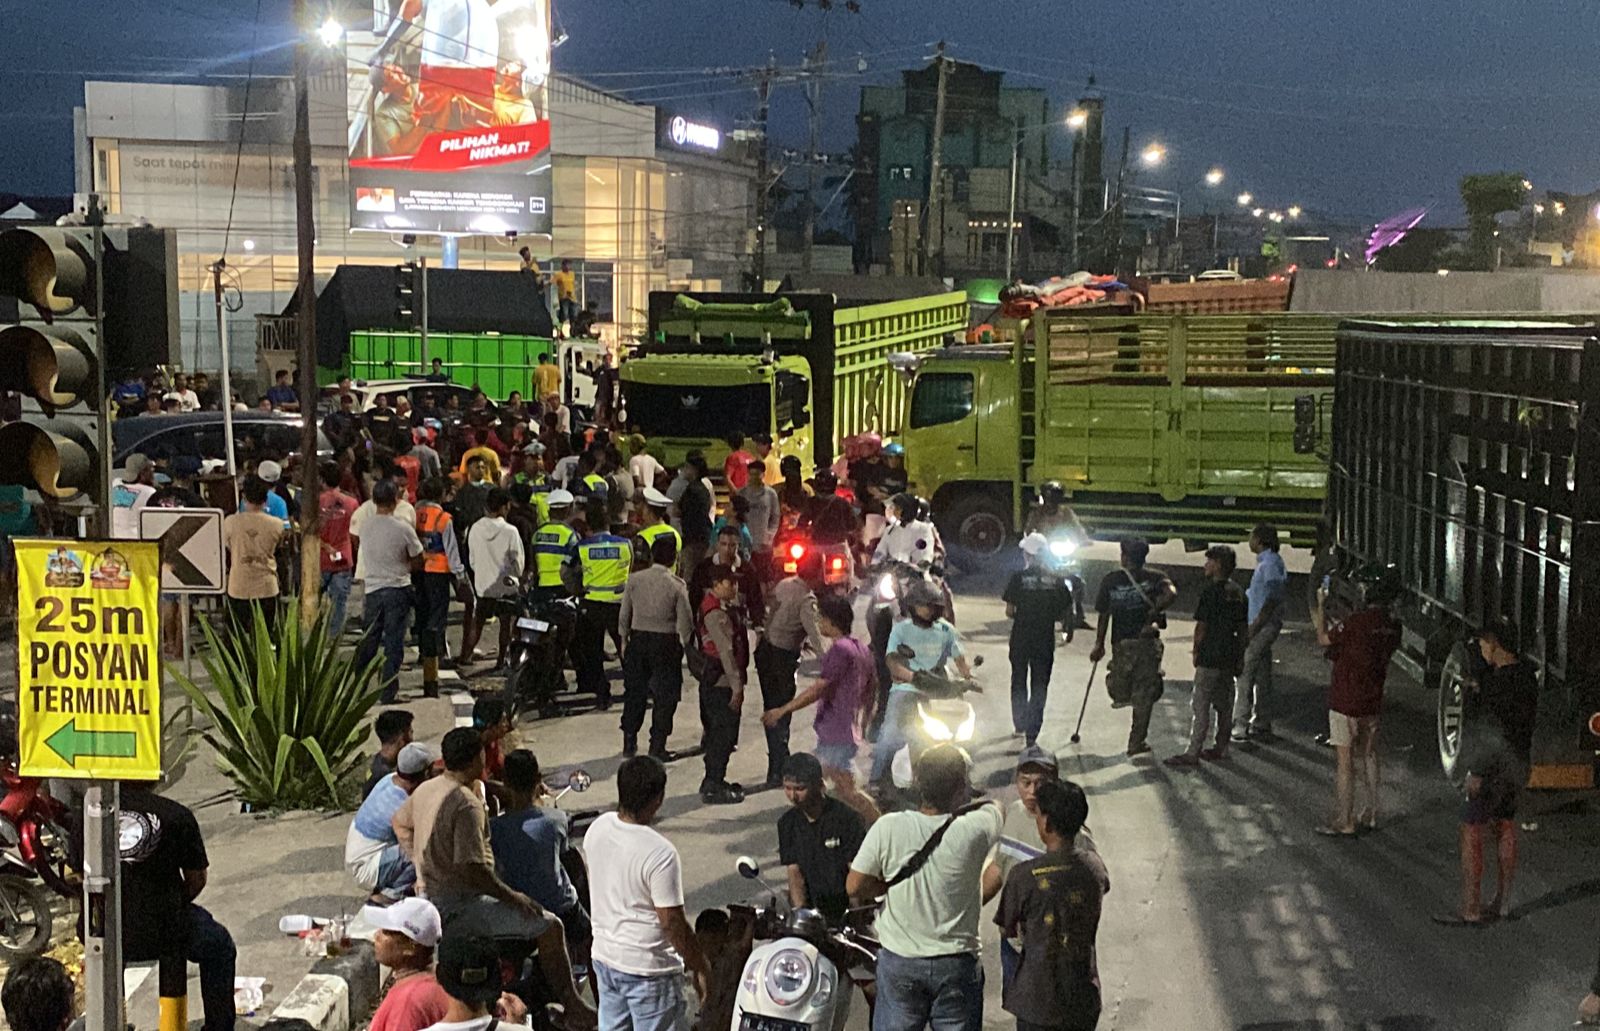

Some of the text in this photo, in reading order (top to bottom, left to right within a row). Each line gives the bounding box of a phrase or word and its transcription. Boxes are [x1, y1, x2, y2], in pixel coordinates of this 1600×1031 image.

[440, 132, 498, 152] PILIHAN
[169, 157, 206, 172] tepat
[589, 548, 619, 559] POLISI
[35, 596, 144, 635] 25m
[30, 640, 149, 681] POSYAN
[30, 686, 150, 715] TERMINAL
